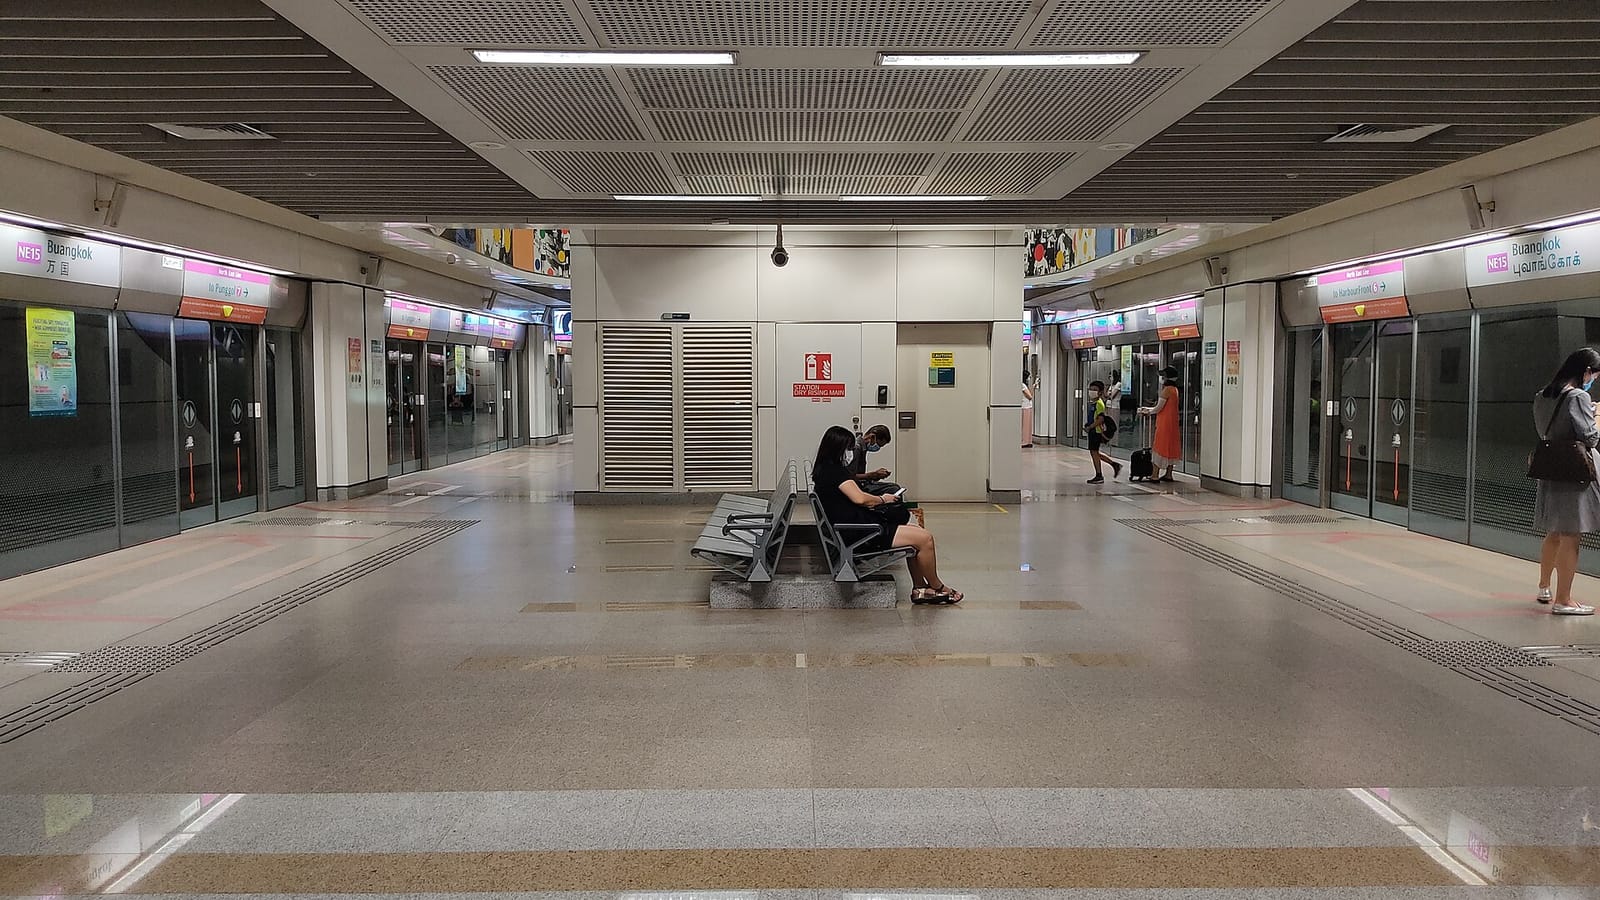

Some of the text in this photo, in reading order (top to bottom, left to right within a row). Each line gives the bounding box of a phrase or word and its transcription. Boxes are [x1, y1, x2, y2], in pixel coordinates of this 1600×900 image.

[18, 245, 41, 261] NE15
[47, 239, 93, 260] Buangkok
[1512, 236, 1561, 256] Buangkok
[46, 259, 70, 276] 万国
[1487, 255, 1508, 270] NE15
[215, 283, 236, 297] Punggol
[1339, 284, 1372, 297] HarbourFront
